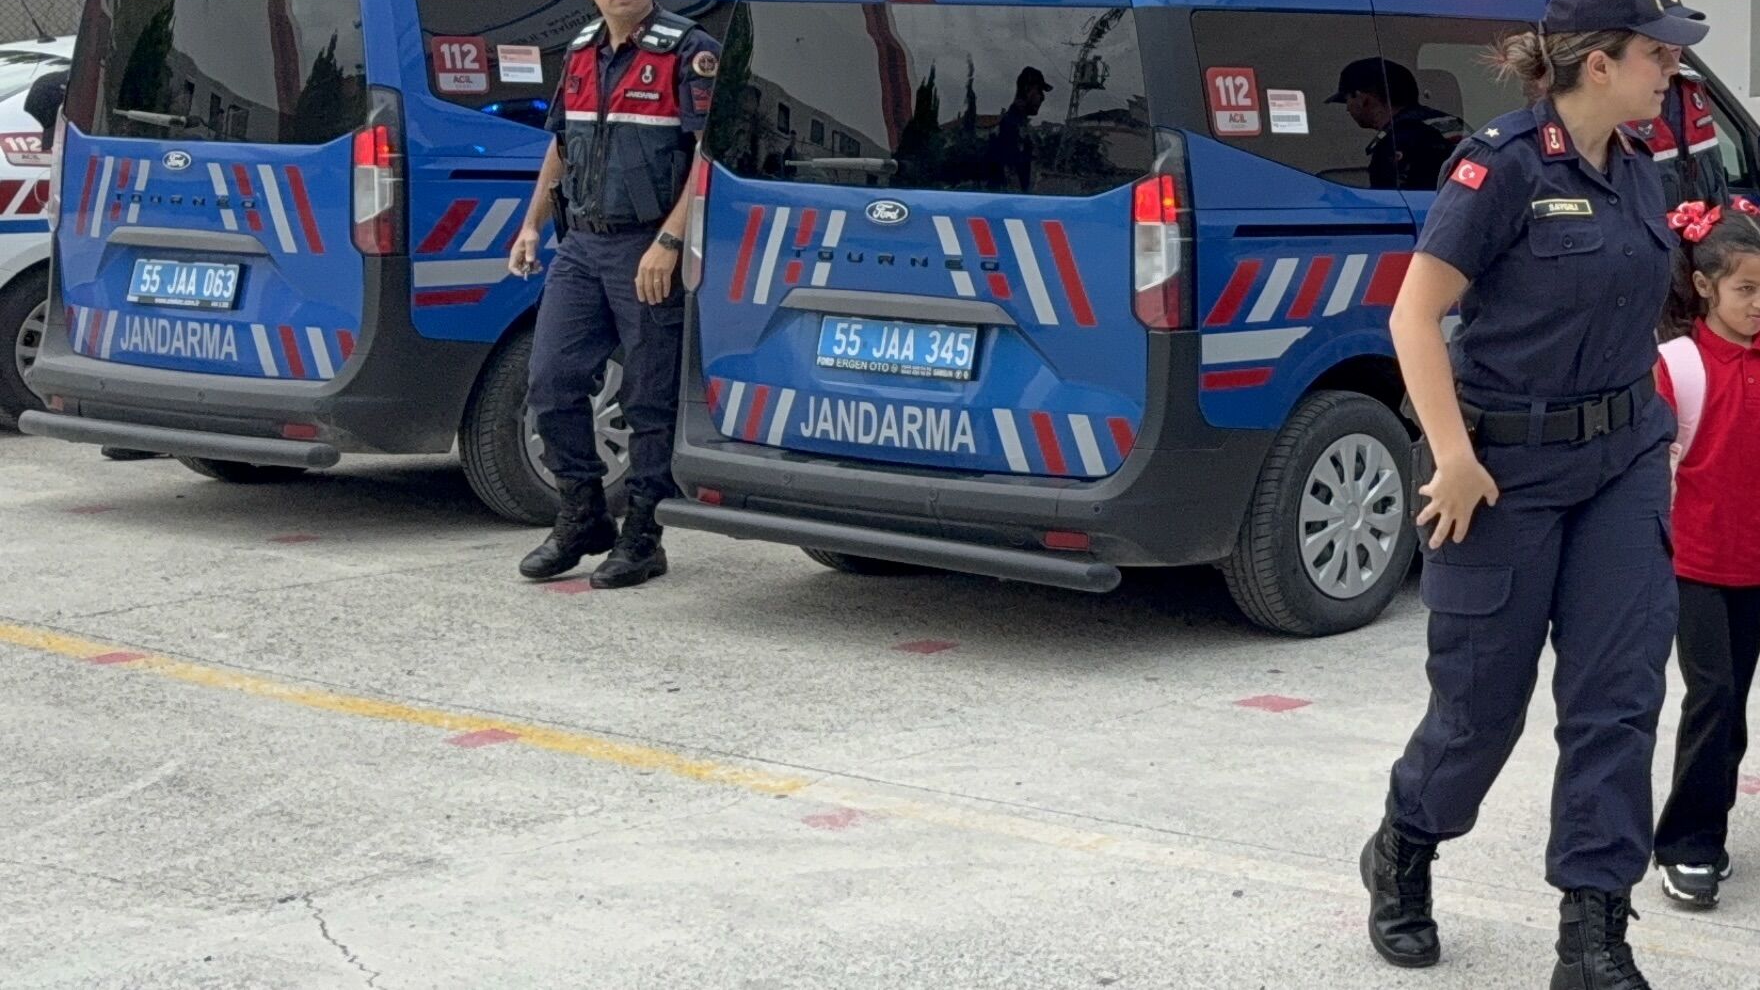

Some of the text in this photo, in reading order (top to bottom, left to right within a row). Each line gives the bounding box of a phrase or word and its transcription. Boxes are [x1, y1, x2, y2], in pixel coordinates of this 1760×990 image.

[441, 43, 480, 69] 112
[1215, 76, 1252, 106] 112
[4, 136, 43, 152] 112
[872, 202, 899, 220] Ford
[792, 246, 1000, 270] TOURNEO
[140, 264, 236, 298] 55 JAA 063
[120, 314, 238, 362] JANDARMA
[832, 322, 972, 367] 55 JAA 345
[836, 358, 868, 371] ERGEN
[869, 361, 890, 373] OTO
[800, 395, 977, 454] JANDARMA
